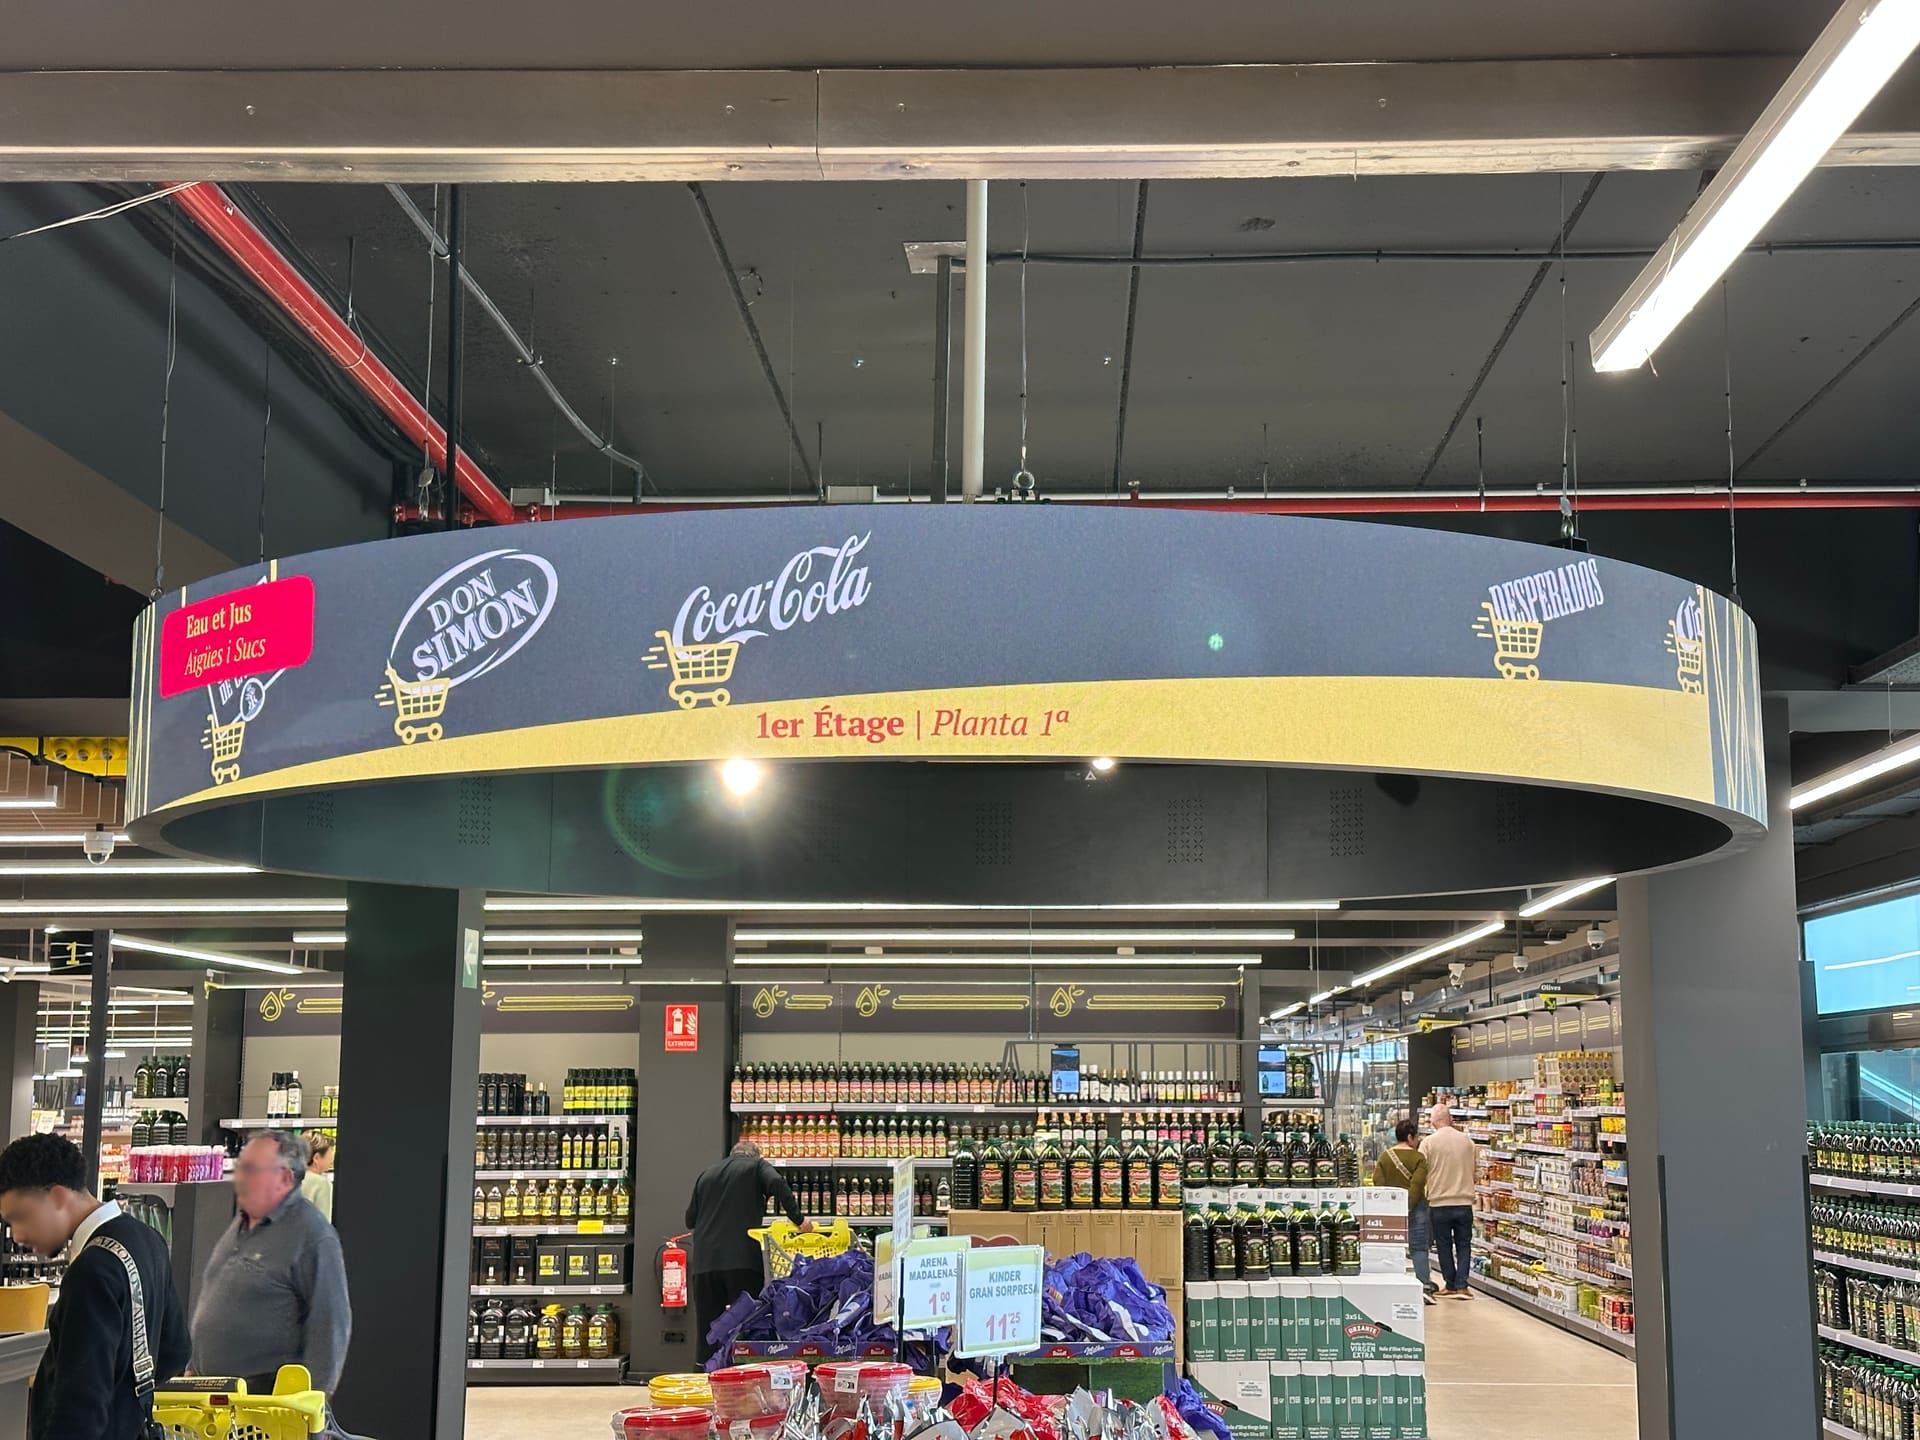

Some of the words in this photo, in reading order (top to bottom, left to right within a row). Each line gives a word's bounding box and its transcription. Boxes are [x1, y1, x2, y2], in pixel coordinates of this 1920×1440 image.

[427, 568, 496, 632] DON
[672, 530, 871, 659] Coca-Cola
[1488, 558, 1604, 632] DESPERADOS
[186, 614, 209, 639] Eau
[212, 607, 225, 630] et
[229, 602, 252, 631] Jus
[412, 578, 539, 682] SIMON
[184, 645, 223, 678] Aigües
[226, 639, 232, 664] i
[234, 637, 266, 662] Sucs
[756, 712, 804, 739] 1er
[813, 705, 905, 744] Étage
[930, 708, 1028, 737] Planta
[66, 941, 80, 966] 1
[1540, 984, 1562, 992] Olives
[909, 1268, 957, 1281] MADALENAS
[920, 1256, 948, 1268] ARENA
[988, 1270, 1021, 1283] KINDER
[969, 1286, 993, 1299] GRAN
[995, 1283, 1039, 1297] SORPRESA
[767, 1344, 788, 1355] Milka
